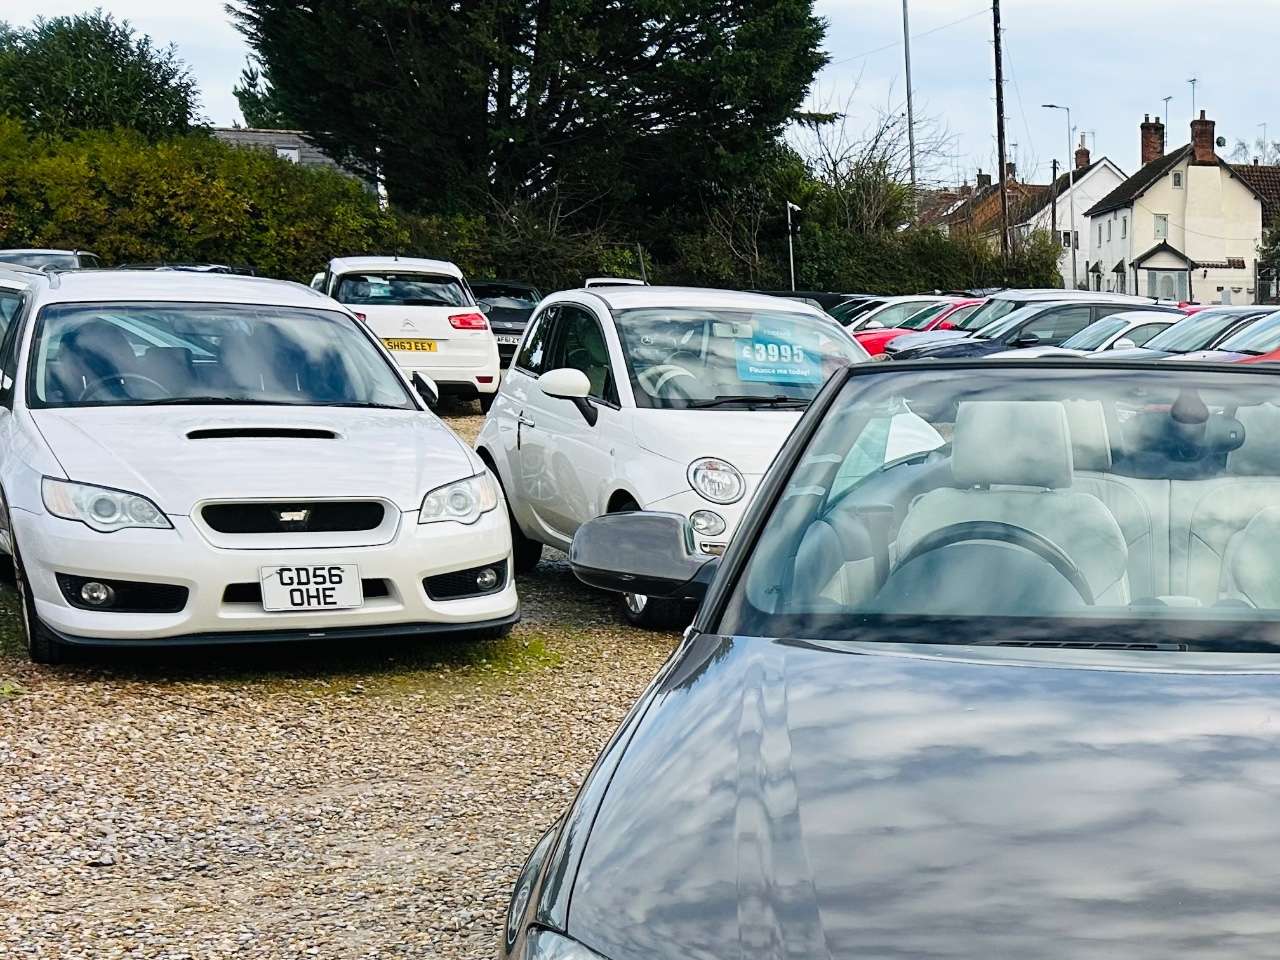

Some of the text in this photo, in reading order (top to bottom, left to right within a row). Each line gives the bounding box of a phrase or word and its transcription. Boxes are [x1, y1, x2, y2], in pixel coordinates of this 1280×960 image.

[387, 341, 433, 351] SH63 EEY
[749, 366, 776, 375] Finance
[279, 566, 343, 586] GD56
[289, 587, 337, 607] OHE
